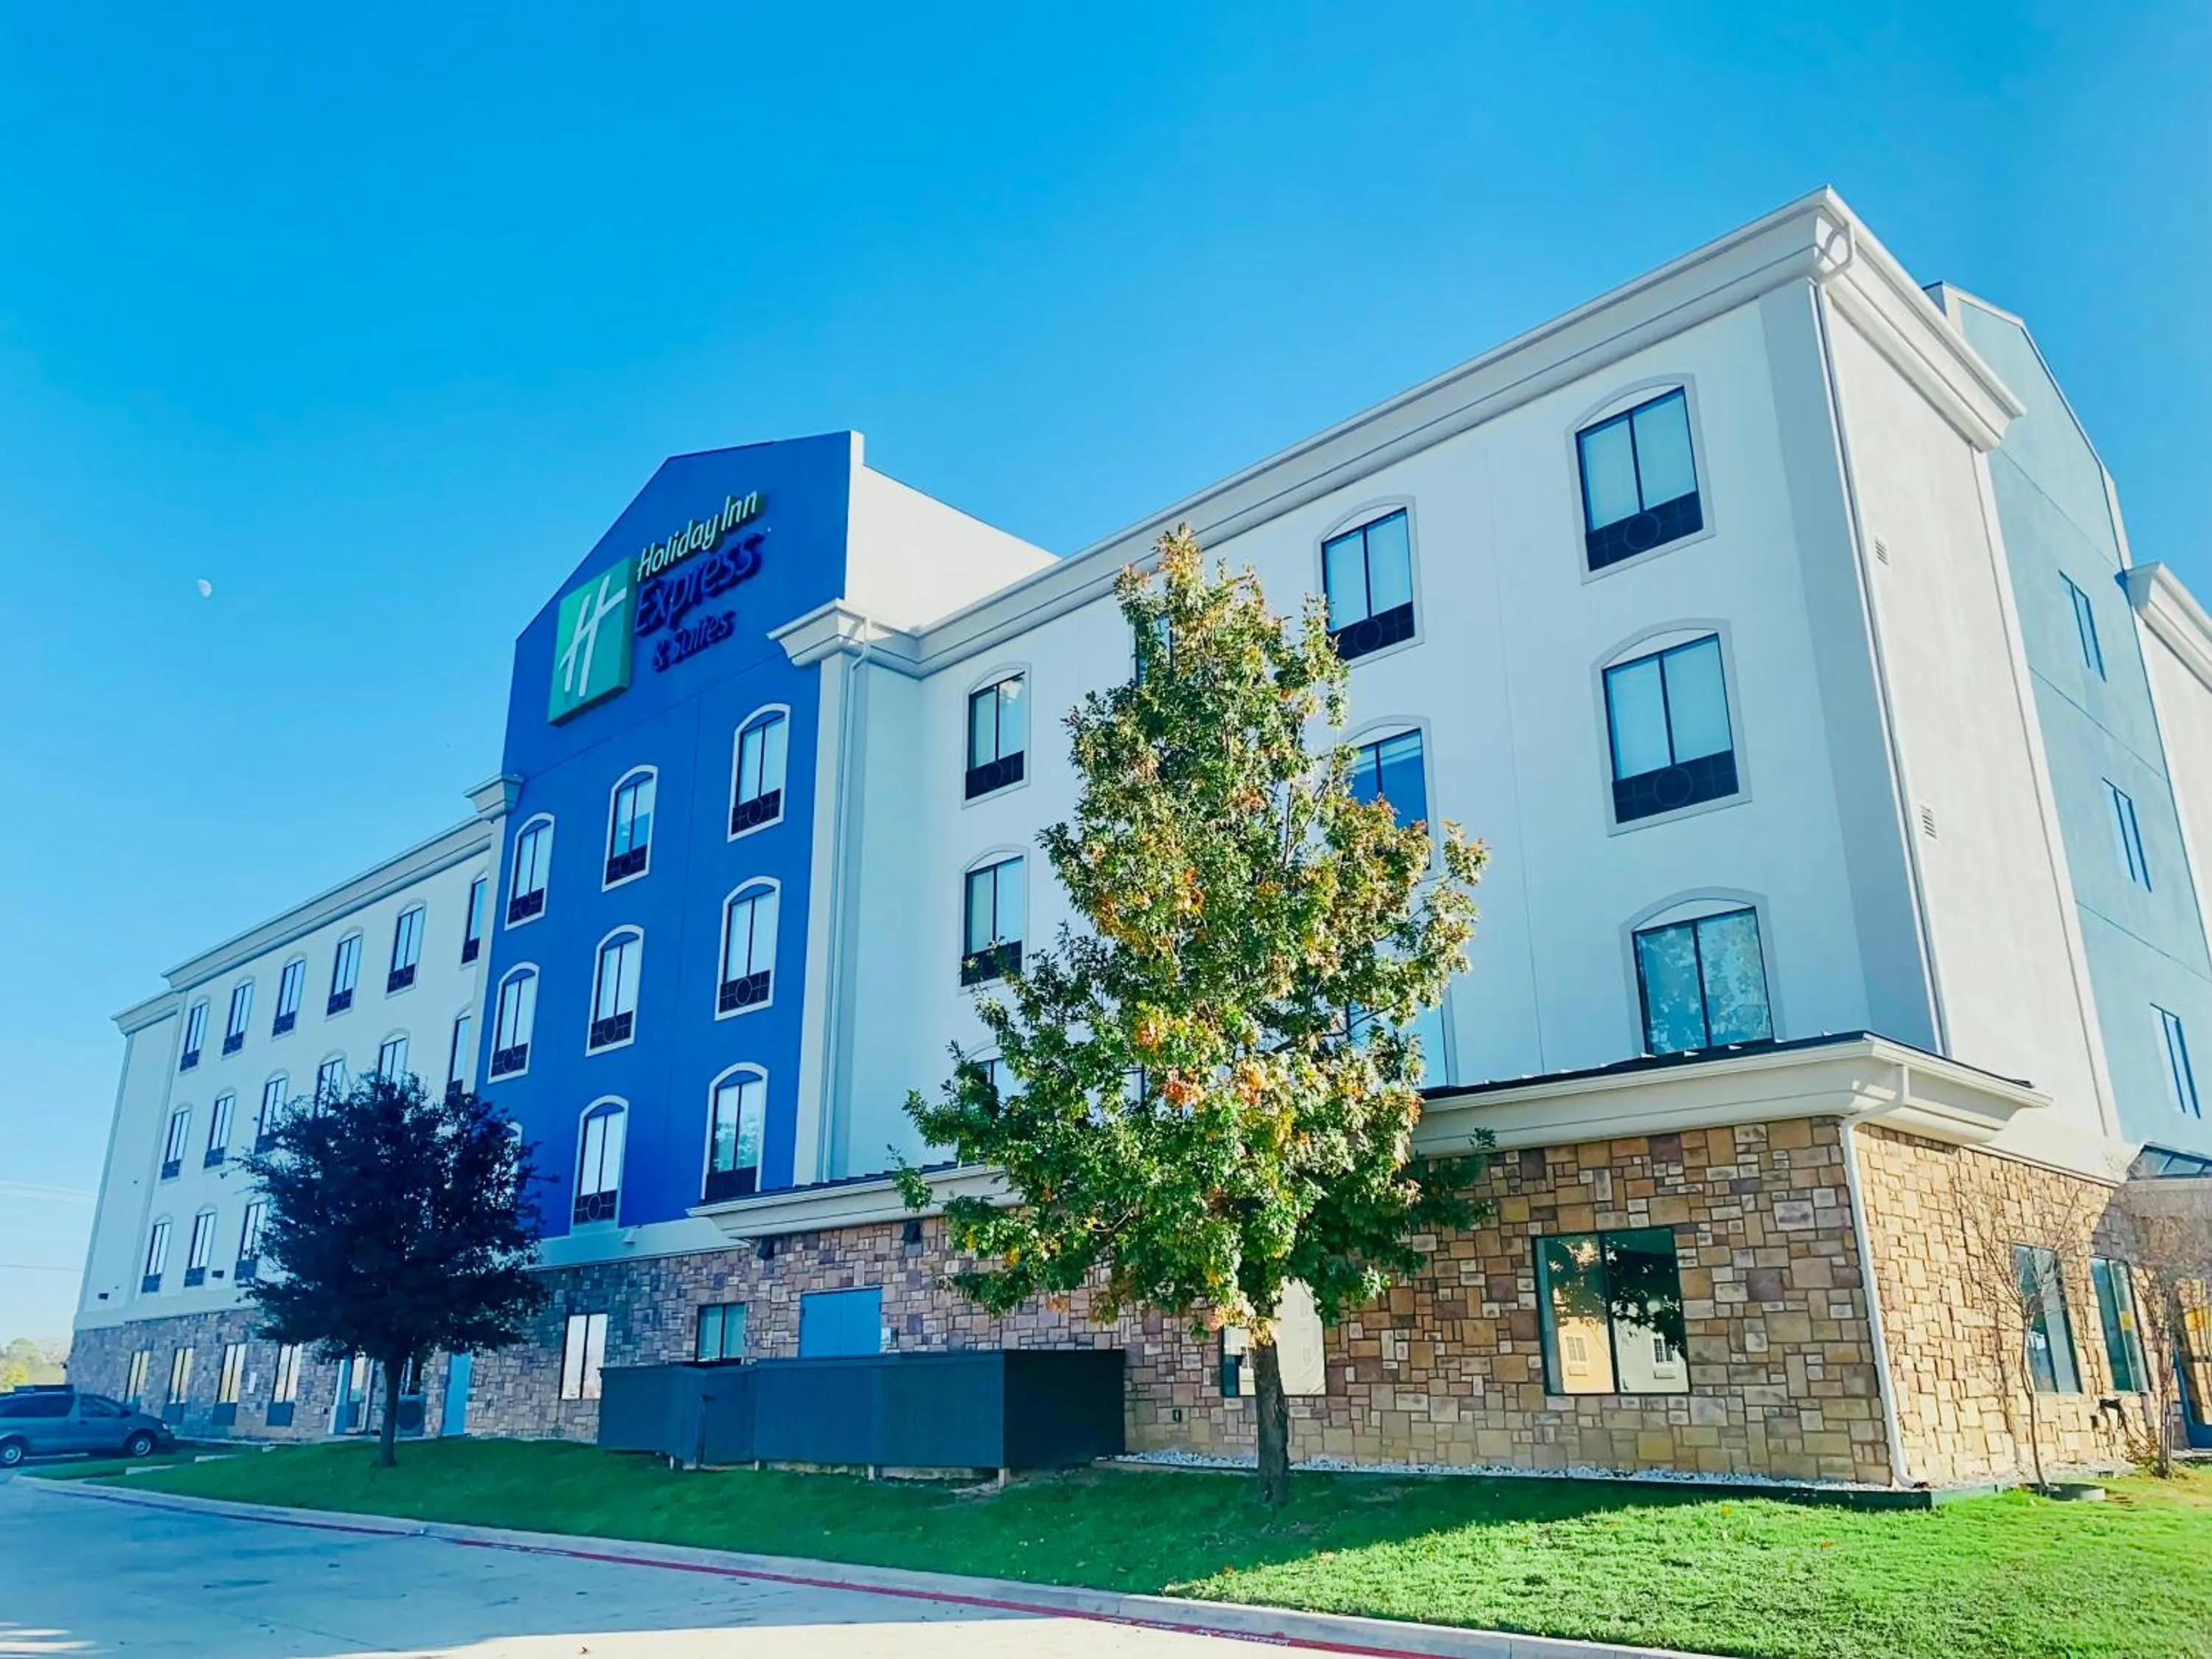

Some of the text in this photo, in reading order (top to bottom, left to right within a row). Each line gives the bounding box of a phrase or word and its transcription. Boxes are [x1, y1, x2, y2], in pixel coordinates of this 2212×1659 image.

[636, 490, 757, 582] Holiday Inn
[635, 532, 765, 636] Express
[653, 610, 736, 673] & Suites
